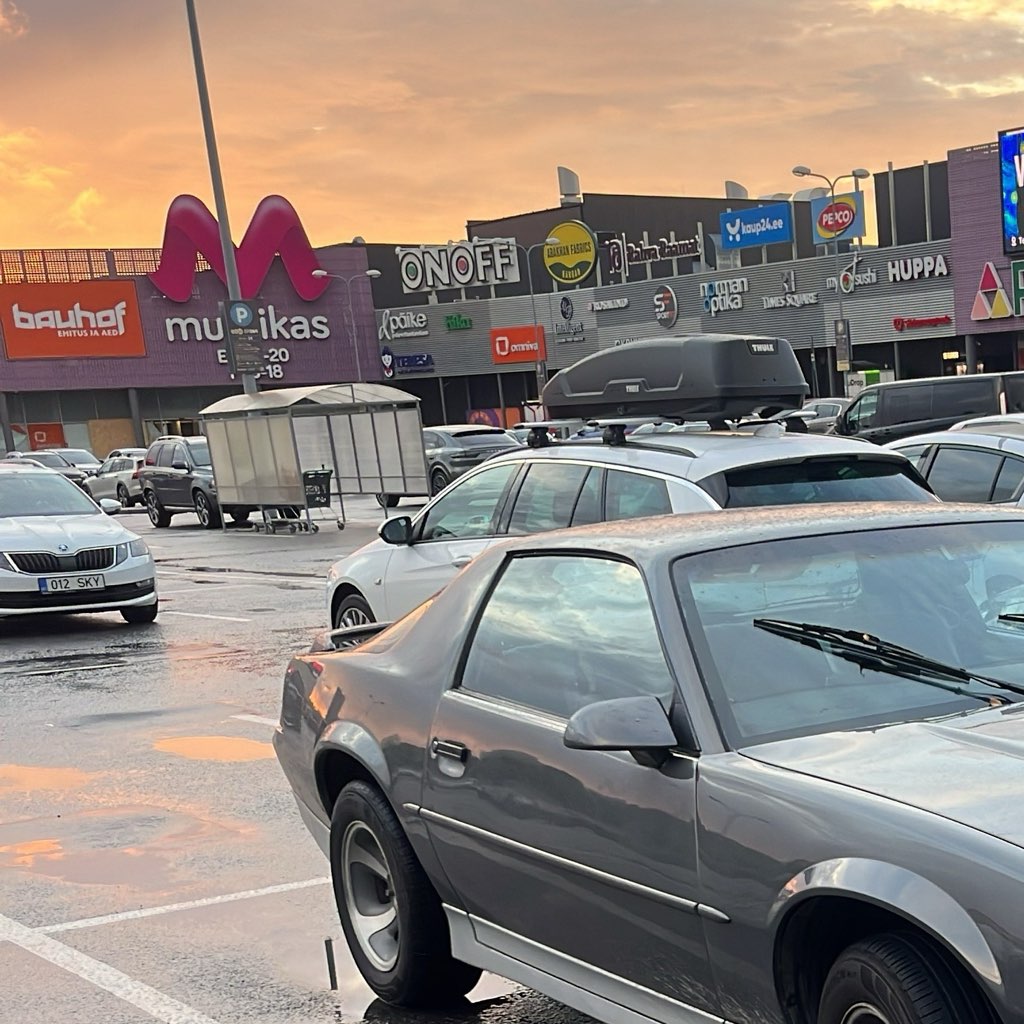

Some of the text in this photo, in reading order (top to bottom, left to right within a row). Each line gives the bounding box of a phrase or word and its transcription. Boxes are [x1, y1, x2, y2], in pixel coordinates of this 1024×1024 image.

[741, 217, 783, 235] kaup24.ee
[400, 242, 513, 290] ONOFF
[888, 254, 948, 282] HUPPA
[700, 278, 748, 297] norman
[826, 268, 877, 294] my sushi
[703, 293, 743, 317] optika
[762, 292, 819, 310] TIMES SQUARE
[12, 301, 126, 336] bauhof
[165, 305, 331, 342] muikas
[101, 329, 119, 337] AED
[510, 341, 539, 352] omniva
[51, 576, 100, 590] 012 SKY
